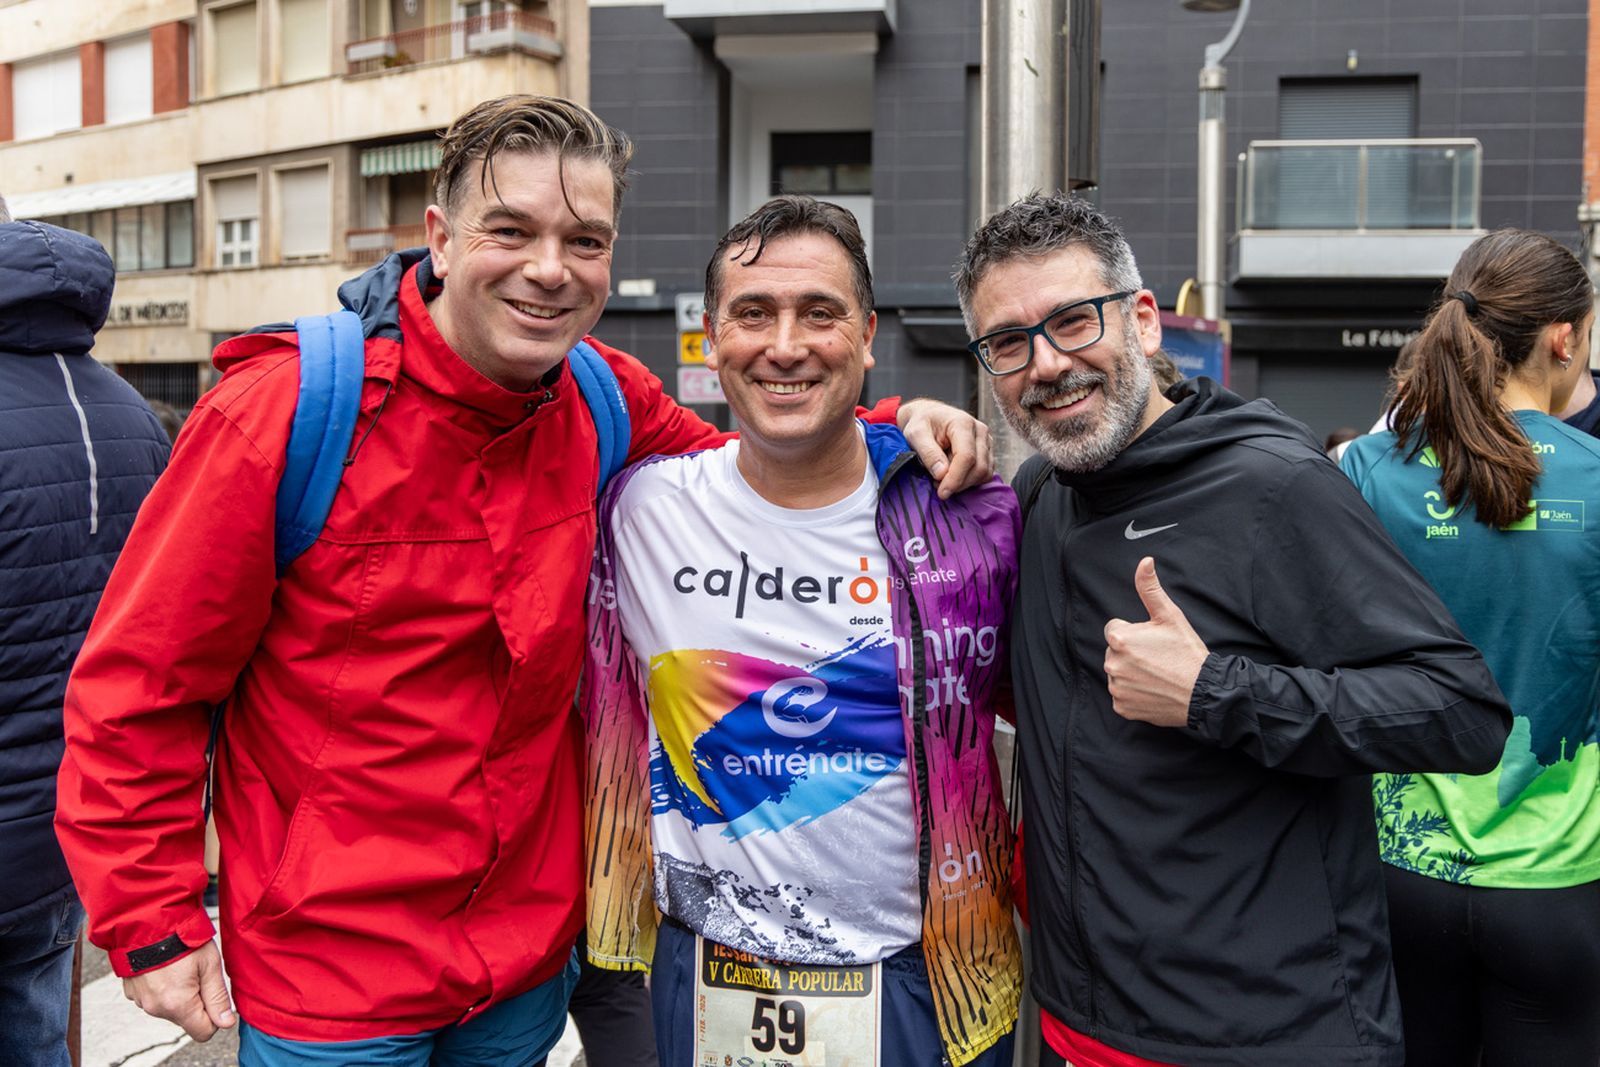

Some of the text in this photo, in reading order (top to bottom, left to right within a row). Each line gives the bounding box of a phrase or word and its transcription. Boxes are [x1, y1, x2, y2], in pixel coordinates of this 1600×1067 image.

[849, 616, 884, 625] desde
[722, 745, 888, 777] entrénate
[708, 961, 864, 992] V CARRERA POPULAR
[751, 997, 806, 1056] 59
